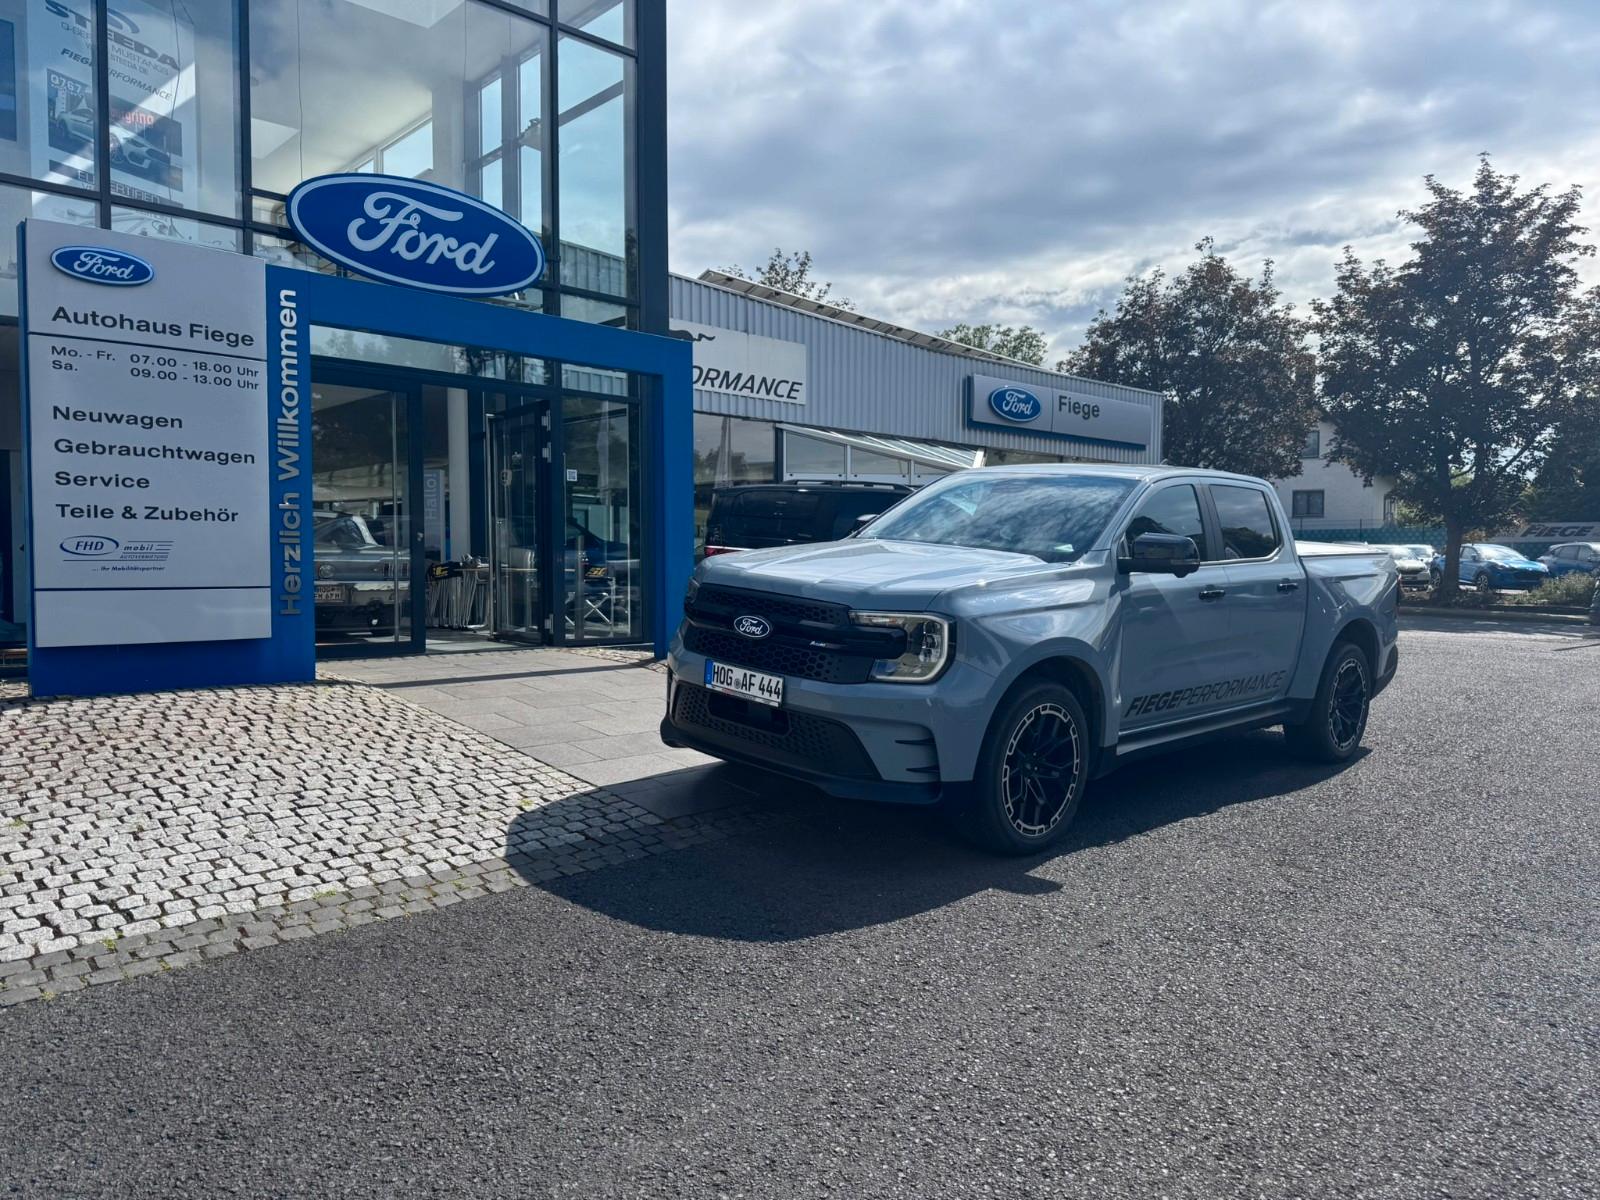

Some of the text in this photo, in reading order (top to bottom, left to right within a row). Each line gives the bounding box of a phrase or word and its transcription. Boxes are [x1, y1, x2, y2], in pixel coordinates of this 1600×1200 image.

[347, 191, 499, 275] Ford
[73, 251, 135, 280] Ford
[52, 306, 255, 347] Autohaus Fiege
[51, 345, 82, 358] Mo.
[96, 350, 116, 361] Fr.
[130, 353, 177, 368] 07.00
[193, 360, 232, 375] 18.00
[237, 366, 259, 378] Uhr
[52, 359, 78, 371] Sa.
[130, 367, 177, 381] 09.00
[193, 374, 232, 387] 13.00
[237, 379, 259, 390] Uhr
[53, 405, 183, 429] Neuwagen
[1002, 390, 1100, 420] Ford Fiege
[54, 438, 255, 465] Gebrauchtwagen
[277, 289, 301, 615] Herzlich Willkommen
[55, 471, 150, 488] Service
[56, 503, 239, 522] Teile & Zubehör
[75, 540, 104, 551] FHD
[739, 617, 763, 635] Ford
[712, 665, 733, 686] HOG
[741, 672, 756, 692] AF
[759, 676, 780, 699] 444
